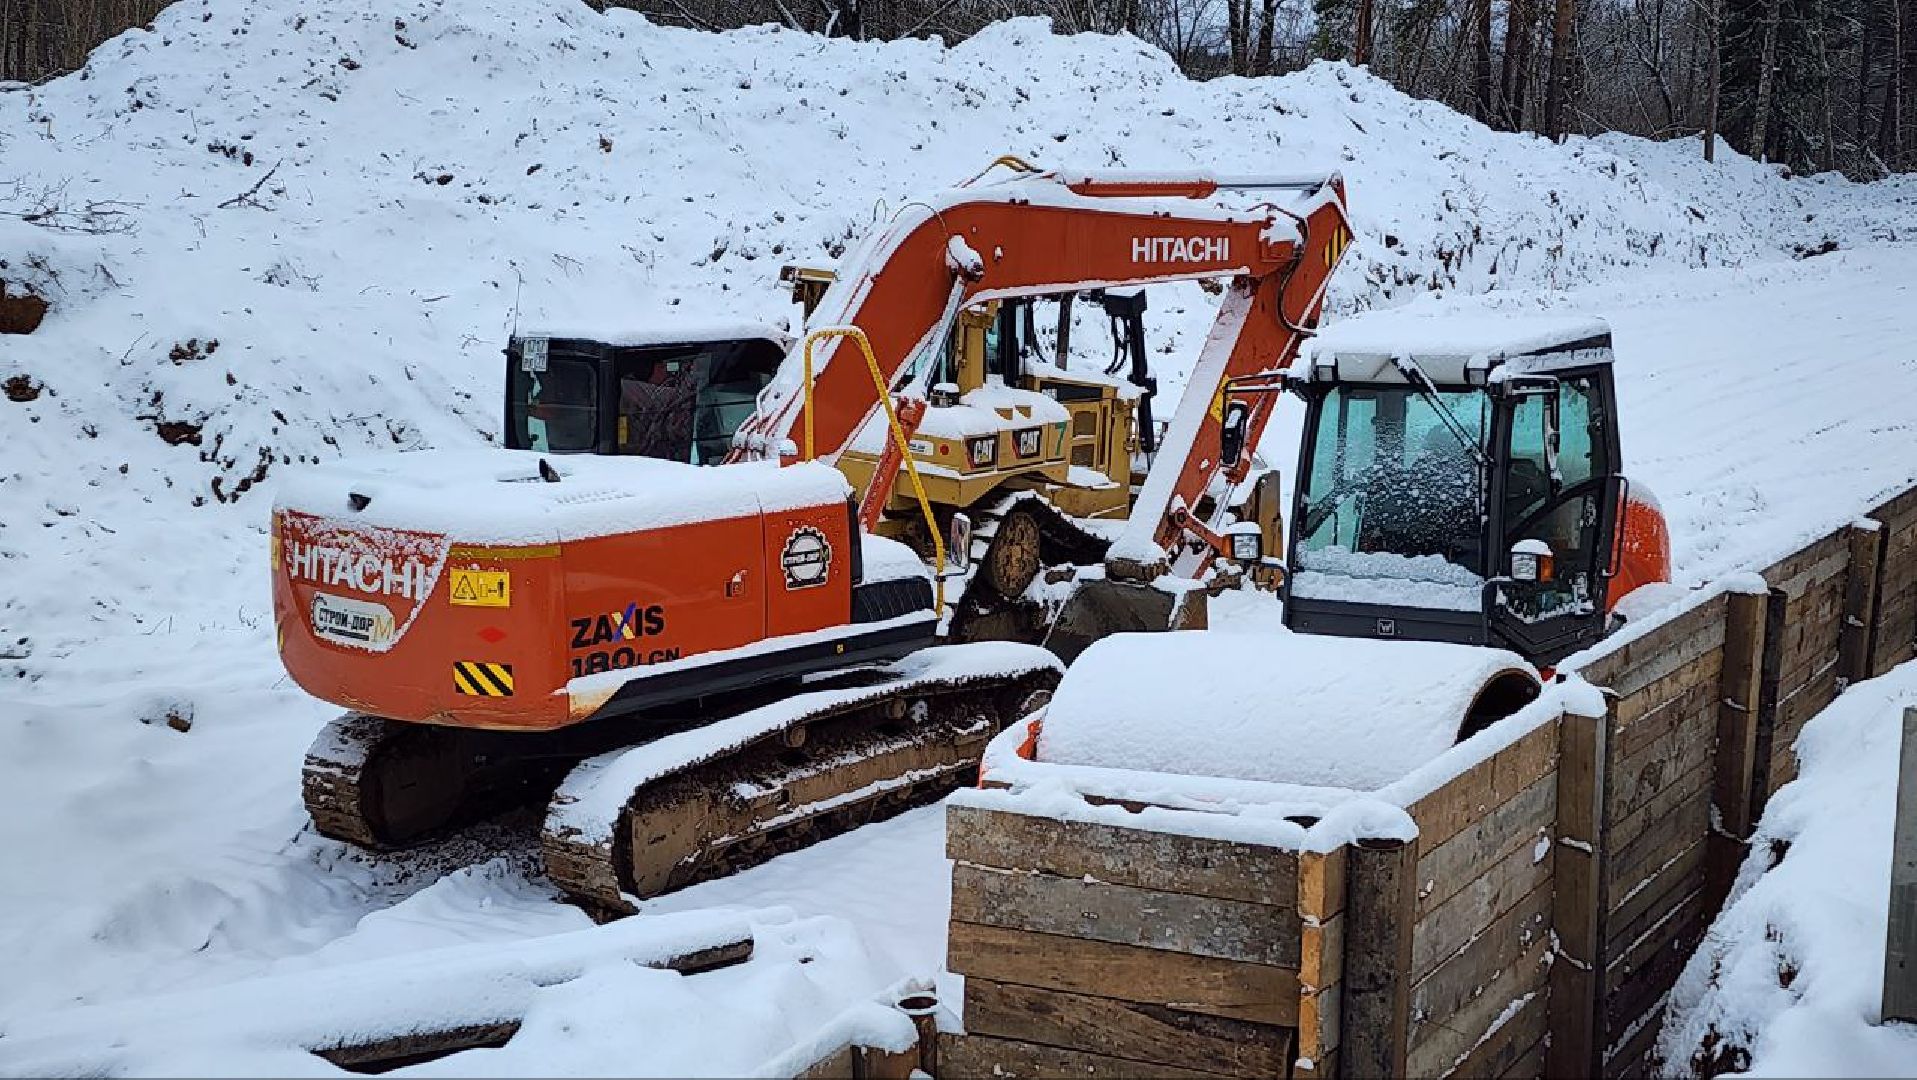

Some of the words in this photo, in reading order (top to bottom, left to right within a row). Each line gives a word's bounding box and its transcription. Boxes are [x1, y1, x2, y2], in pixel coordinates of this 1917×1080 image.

[1132, 236, 1229, 263] HITACHI
[974, 439, 995, 465] CAT
[1021, 430, 1039, 456] CAT
[1055, 421, 1068, 457] 7
[291, 541, 425, 601] HITACHI
[571, 602, 664, 649] ZAXIS
